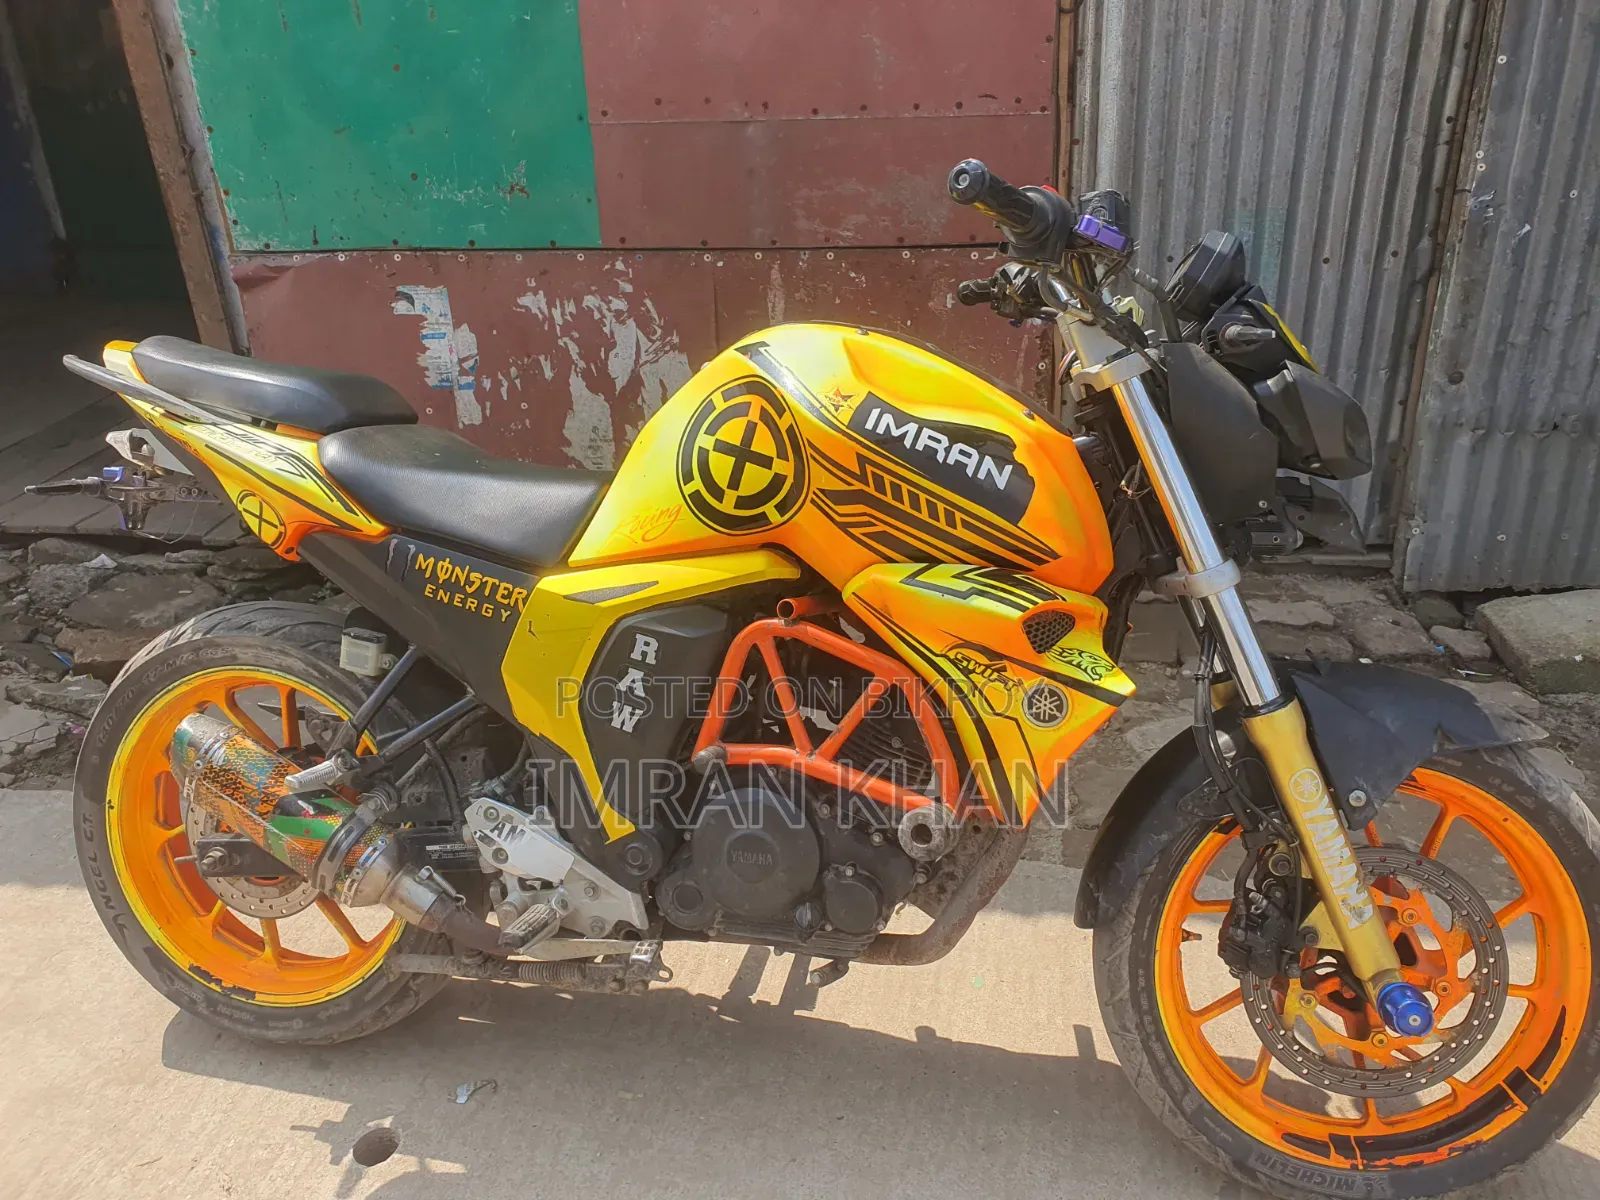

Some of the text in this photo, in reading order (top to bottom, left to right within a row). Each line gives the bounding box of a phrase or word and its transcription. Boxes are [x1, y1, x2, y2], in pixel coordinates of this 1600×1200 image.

[864, 407, 1013, 491] IMRAN
[424, 583, 511, 622] ENERGY
[953, 651, 1019, 691] SWIFT
[731, 850, 773, 866] YAMAHA
[1302, 794, 1374, 930] YAMAHA
[1254, 1152, 1357, 1191] MICHELIN
